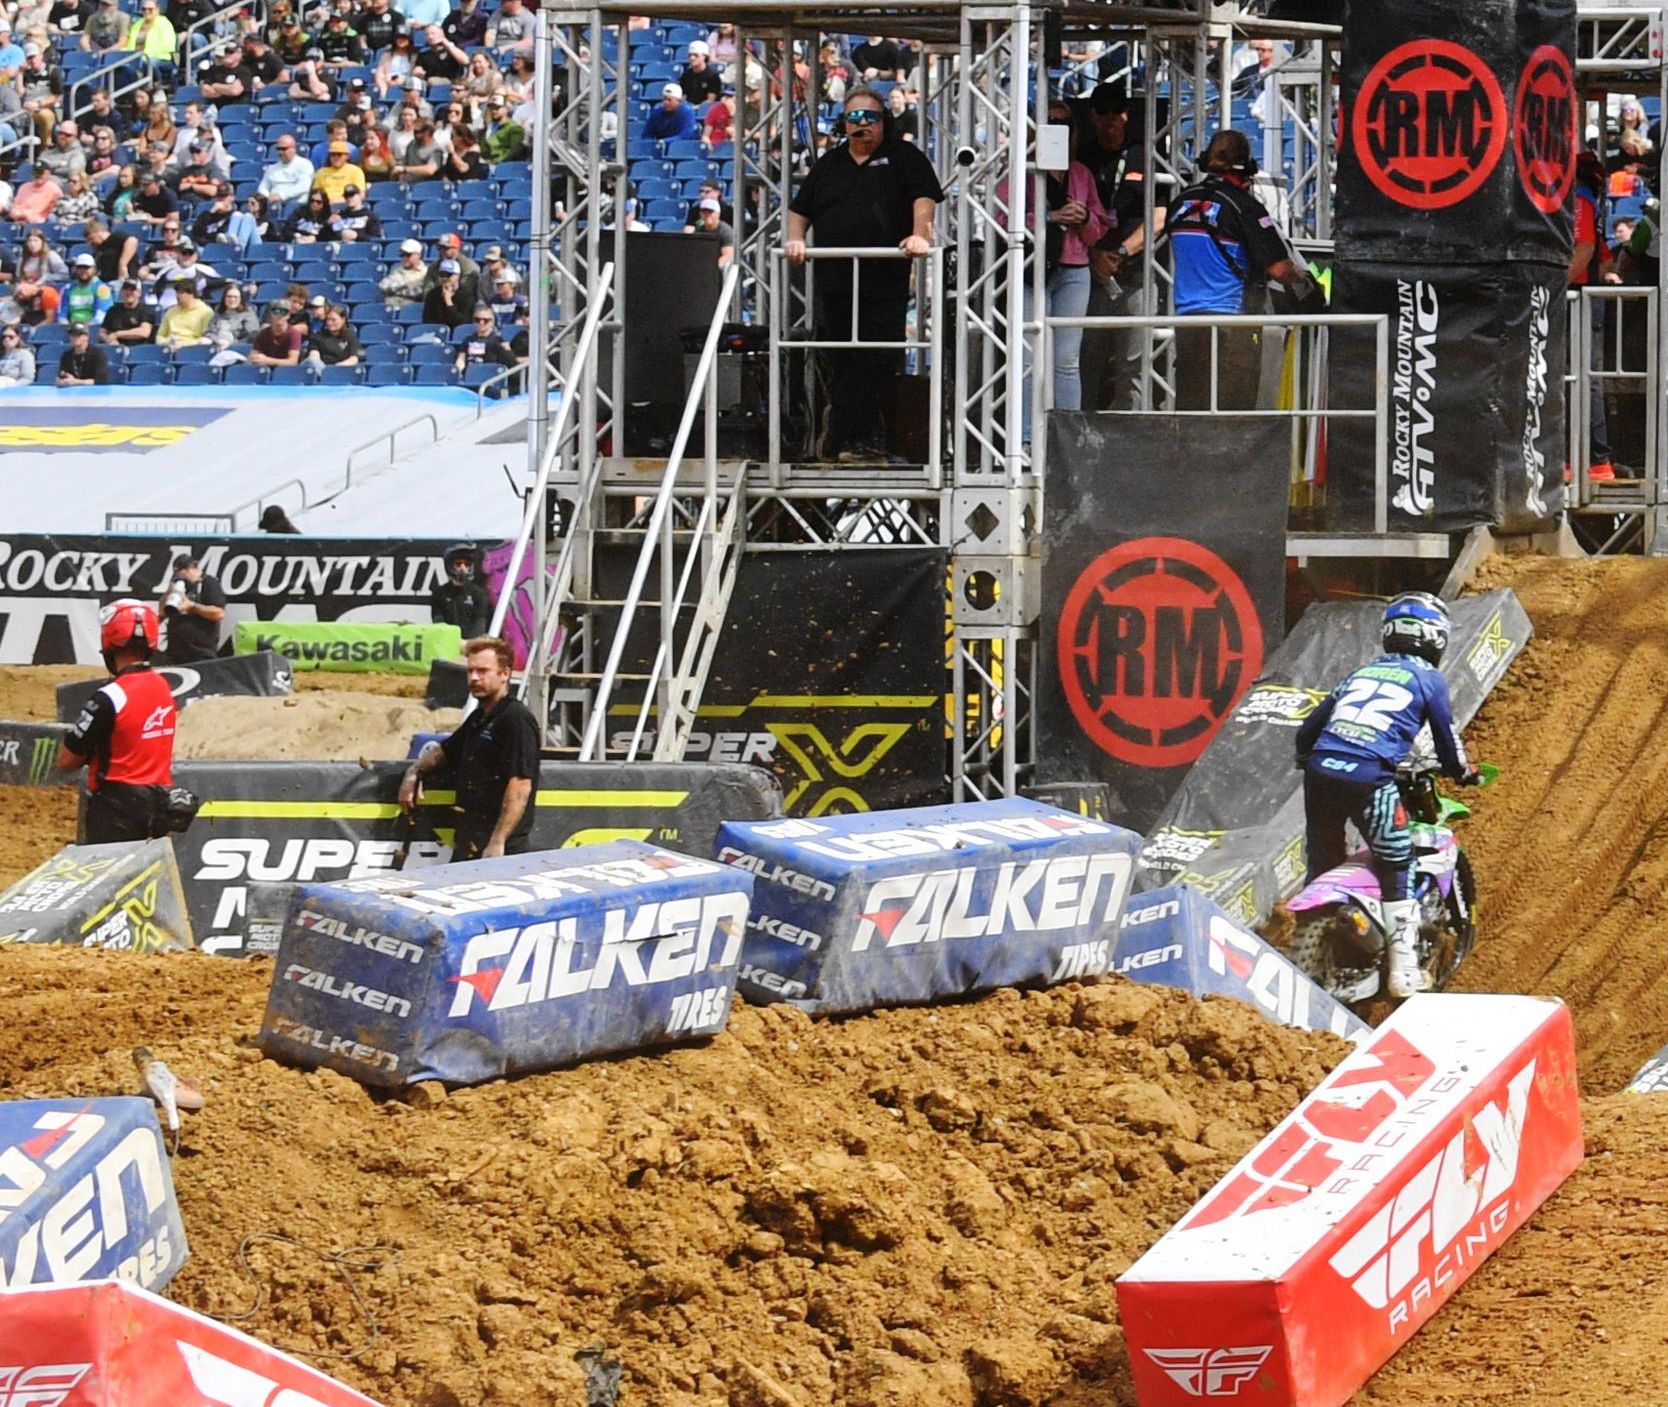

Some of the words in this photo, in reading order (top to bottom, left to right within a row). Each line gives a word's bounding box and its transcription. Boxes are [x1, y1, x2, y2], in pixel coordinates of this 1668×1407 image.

[1385, 92, 1488, 154] RM
[1393, 278, 1414, 403] MOUNTAIN
[1392, 404, 1411, 479] ROCKY
[0, 541, 151, 593] ROCKY
[155, 544, 450, 597] MOUNTAIN
[255, 633, 424, 665] Kawasaki
[1099, 605, 1230, 702] RM
[1330, 678, 1414, 732] 22
[193, 838, 454, 883] SUPER
[716, 845, 836, 902] FALKEN
[852, 851, 1134, 953] FALKEN
[1120, 899, 1181, 930] KEN
[299, 908, 423, 965] FALKEN
[448, 891, 751, 1019] FALKEN
[1051, 939, 1110, 980] TIRES
[284, 963, 412, 1018] FALKEN
[665, 986, 727, 1035] TIRES
[274, 1017, 399, 1072] FALKEN
[1179, 1028, 1437, 1231] FLY
[1329, 1075, 1463, 1195] RACING
[0, 1127, 162, 1287] KEN
[1328, 1057, 1536, 1310] FLY
[1387, 1204, 1508, 1336] RACING
